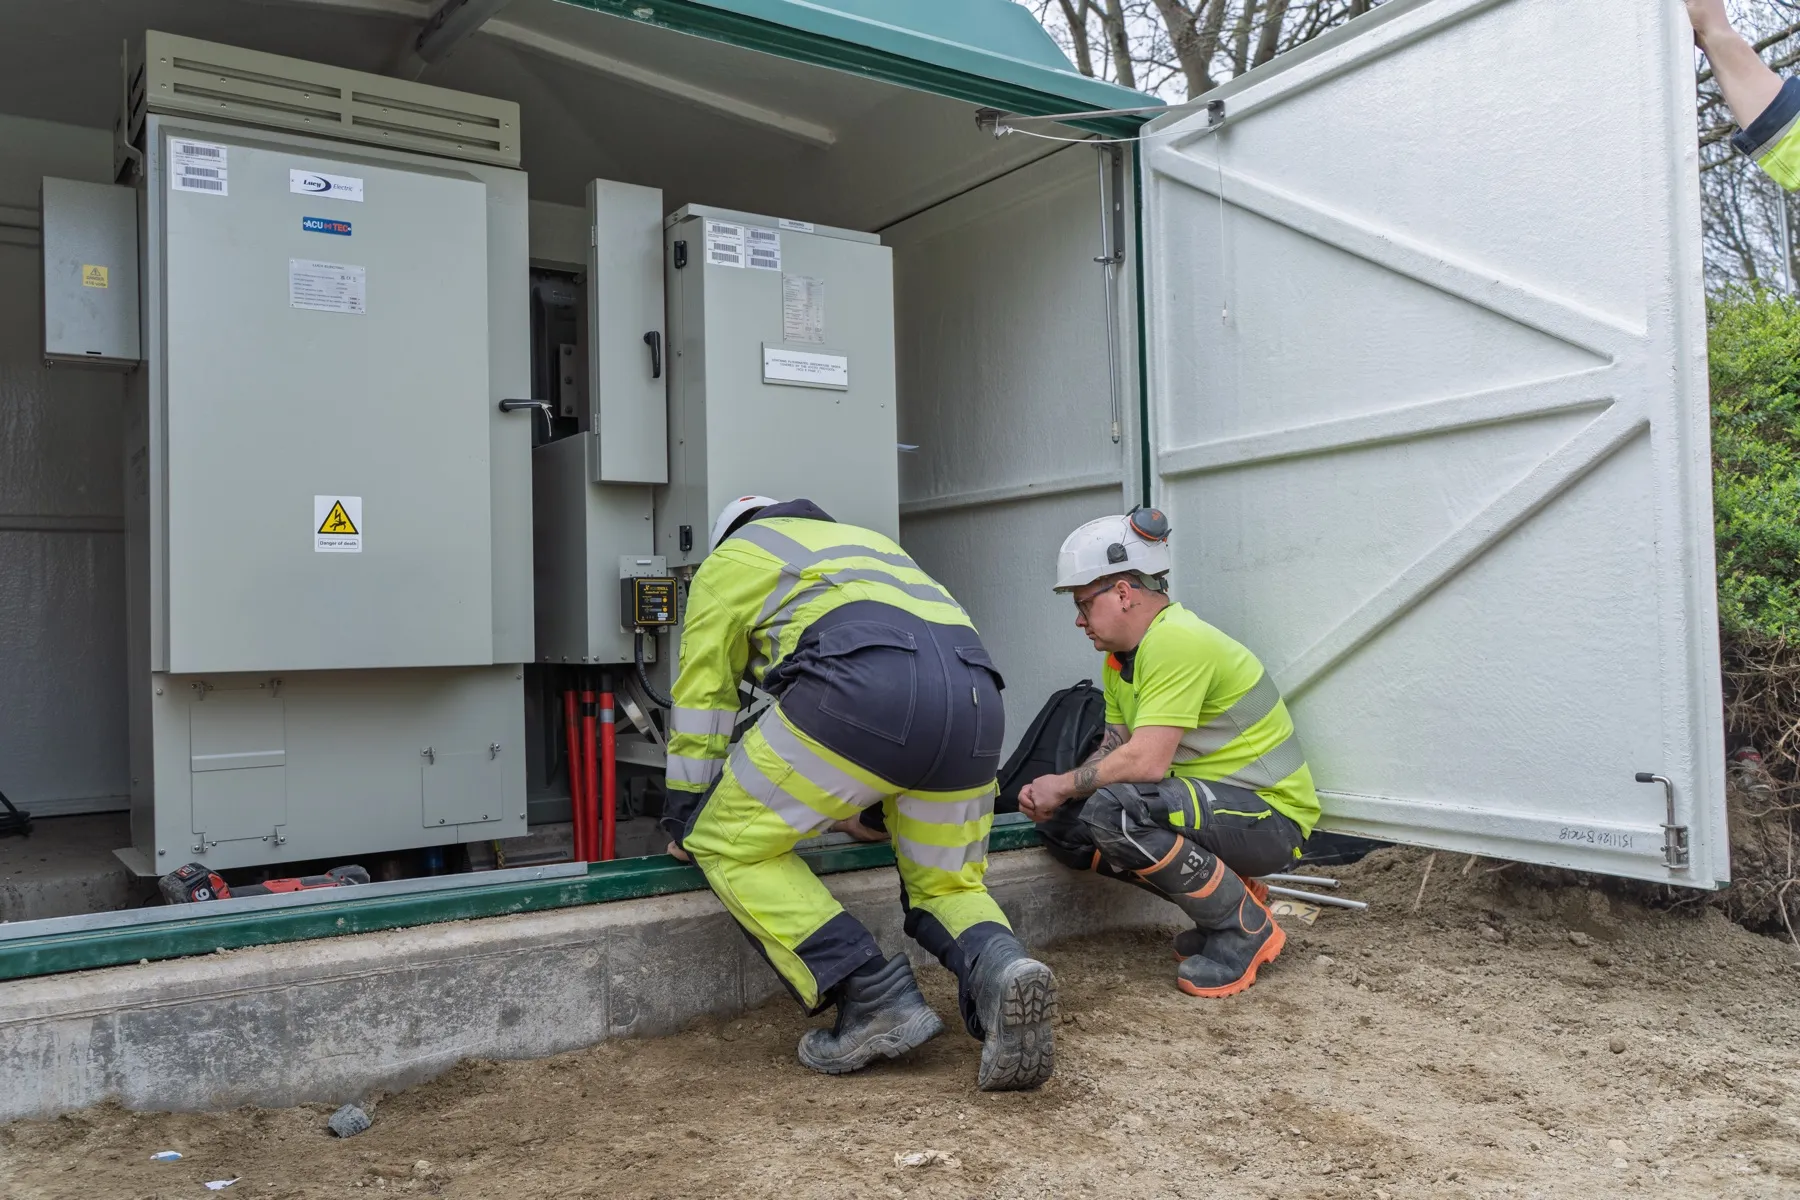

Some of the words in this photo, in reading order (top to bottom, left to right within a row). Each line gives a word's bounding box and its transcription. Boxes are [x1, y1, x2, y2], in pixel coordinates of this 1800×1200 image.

[303, 179, 322, 188] Lucy
[333, 183, 353, 192] Electric
[333, 222, 348, 232] TEC
